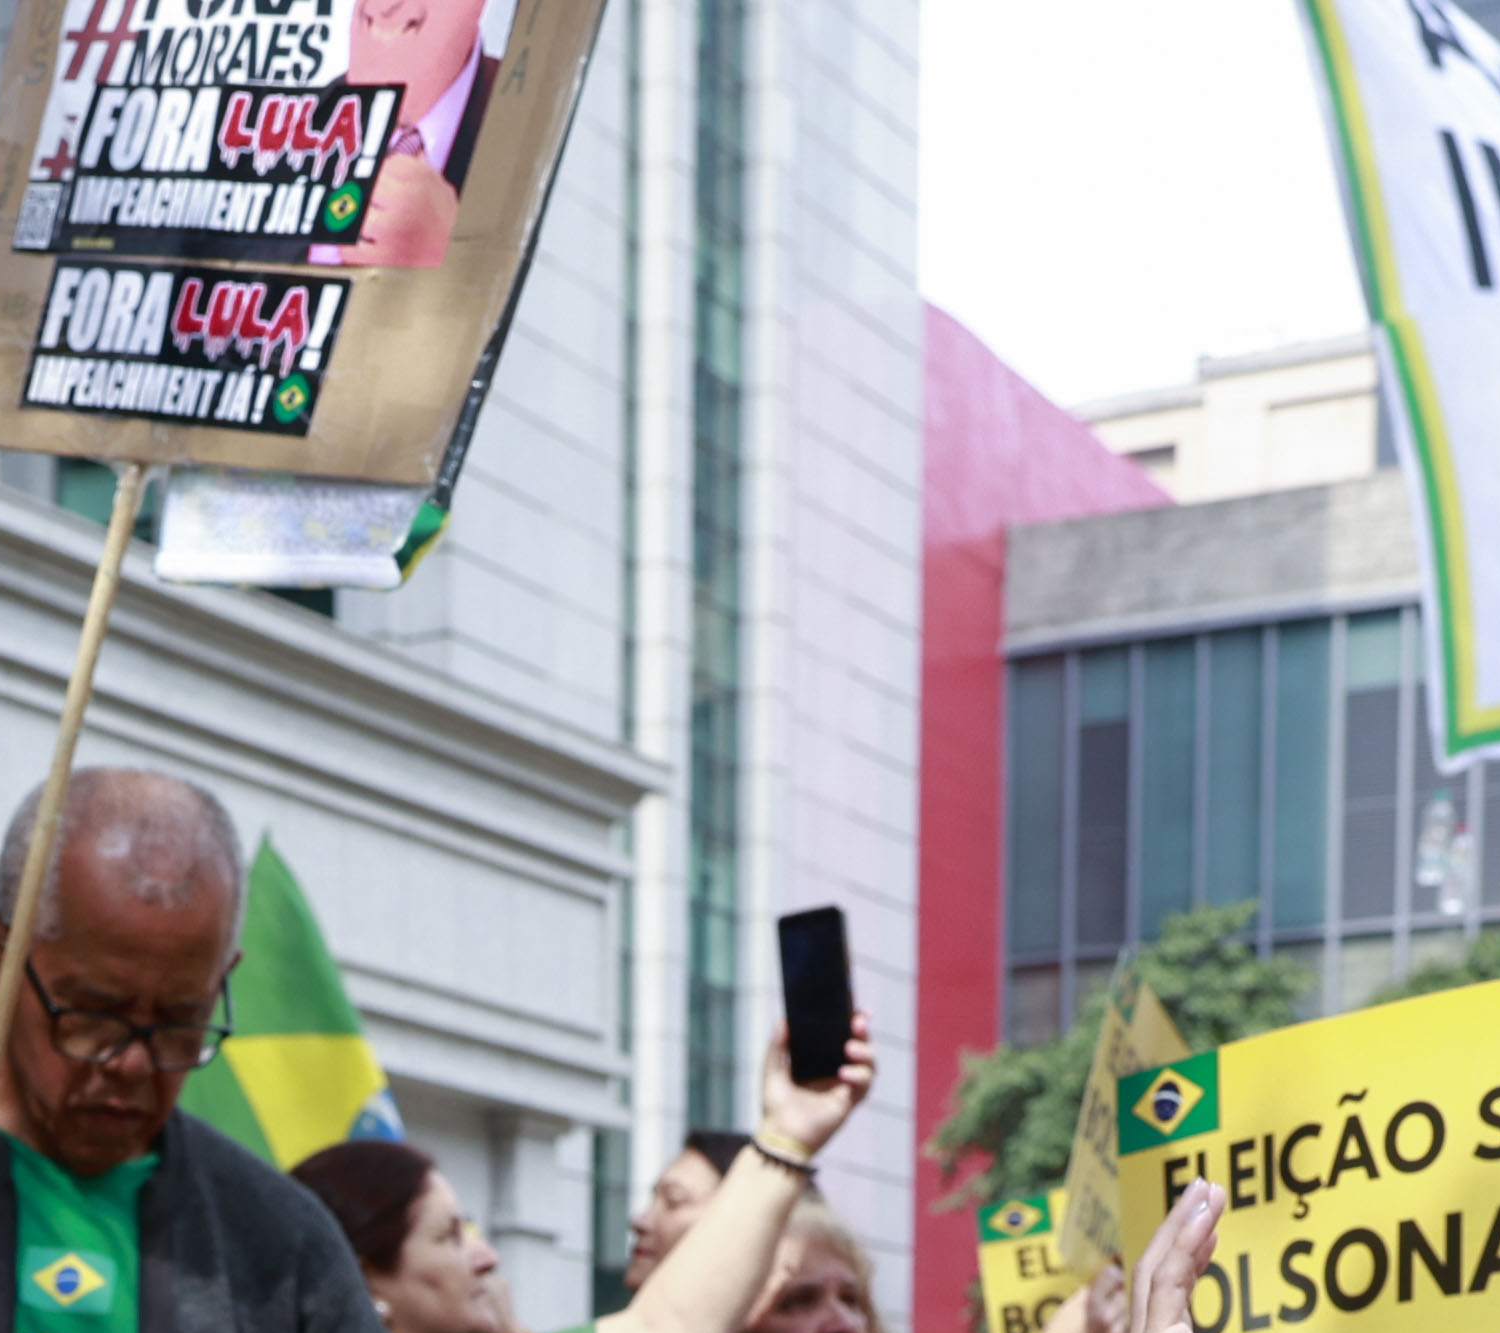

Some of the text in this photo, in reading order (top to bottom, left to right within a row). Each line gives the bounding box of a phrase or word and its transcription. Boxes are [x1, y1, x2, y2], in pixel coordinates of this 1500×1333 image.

[129, 23, 333, 86] MORAES
[80, 87, 221, 173] FORA
[69, 176, 325, 234] IMPEACHMENT JÁ!
[41, 267, 174, 355] FORA
[27, 355, 274, 424] IMPEACHMENT JÁ!
[1163, 1089, 1447, 1219] EEIÇÃO
